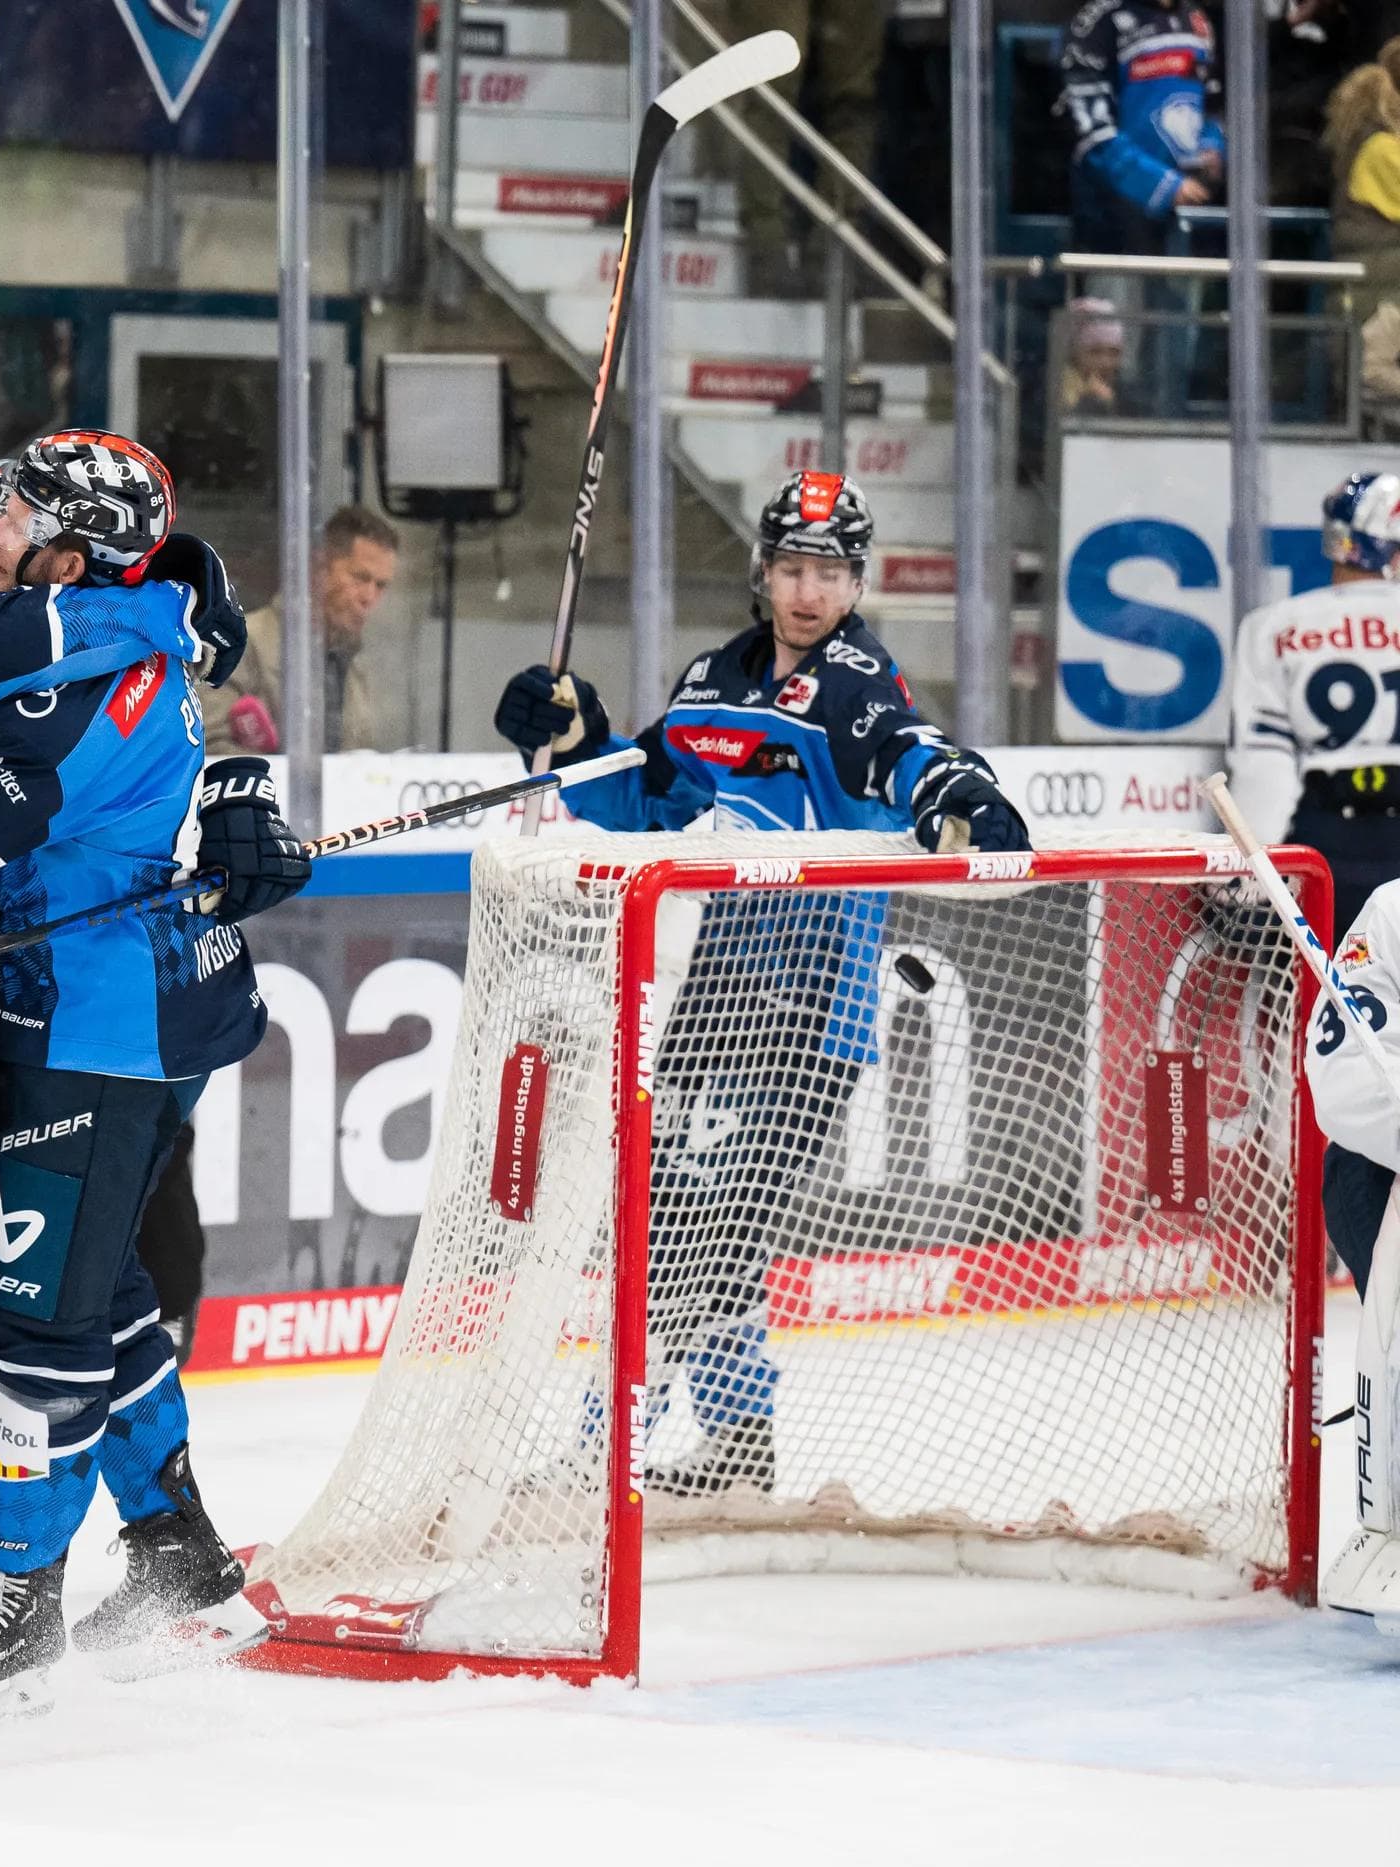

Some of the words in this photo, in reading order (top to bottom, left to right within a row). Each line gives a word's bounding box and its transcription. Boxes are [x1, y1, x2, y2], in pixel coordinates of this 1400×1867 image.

[150, 493, 165, 508] 86
[569, 445, 605, 559] SYNC
[1274, 616, 1354, 660] Red
[1, 1011, 45, 1030] BAUER
[513, 1055, 536, 1157] Ingolstadt
[1166, 1060, 1188, 1155] Ingolstadt
[0, 1111, 94, 1154] BAUER
[509, 1160, 522, 1180] in
[1168, 1157, 1186, 1177] in
[508, 1182, 520, 1209] 4x
[1170, 1178, 1186, 1205] 4x
[1355, 1371, 1374, 1520] TRUE
